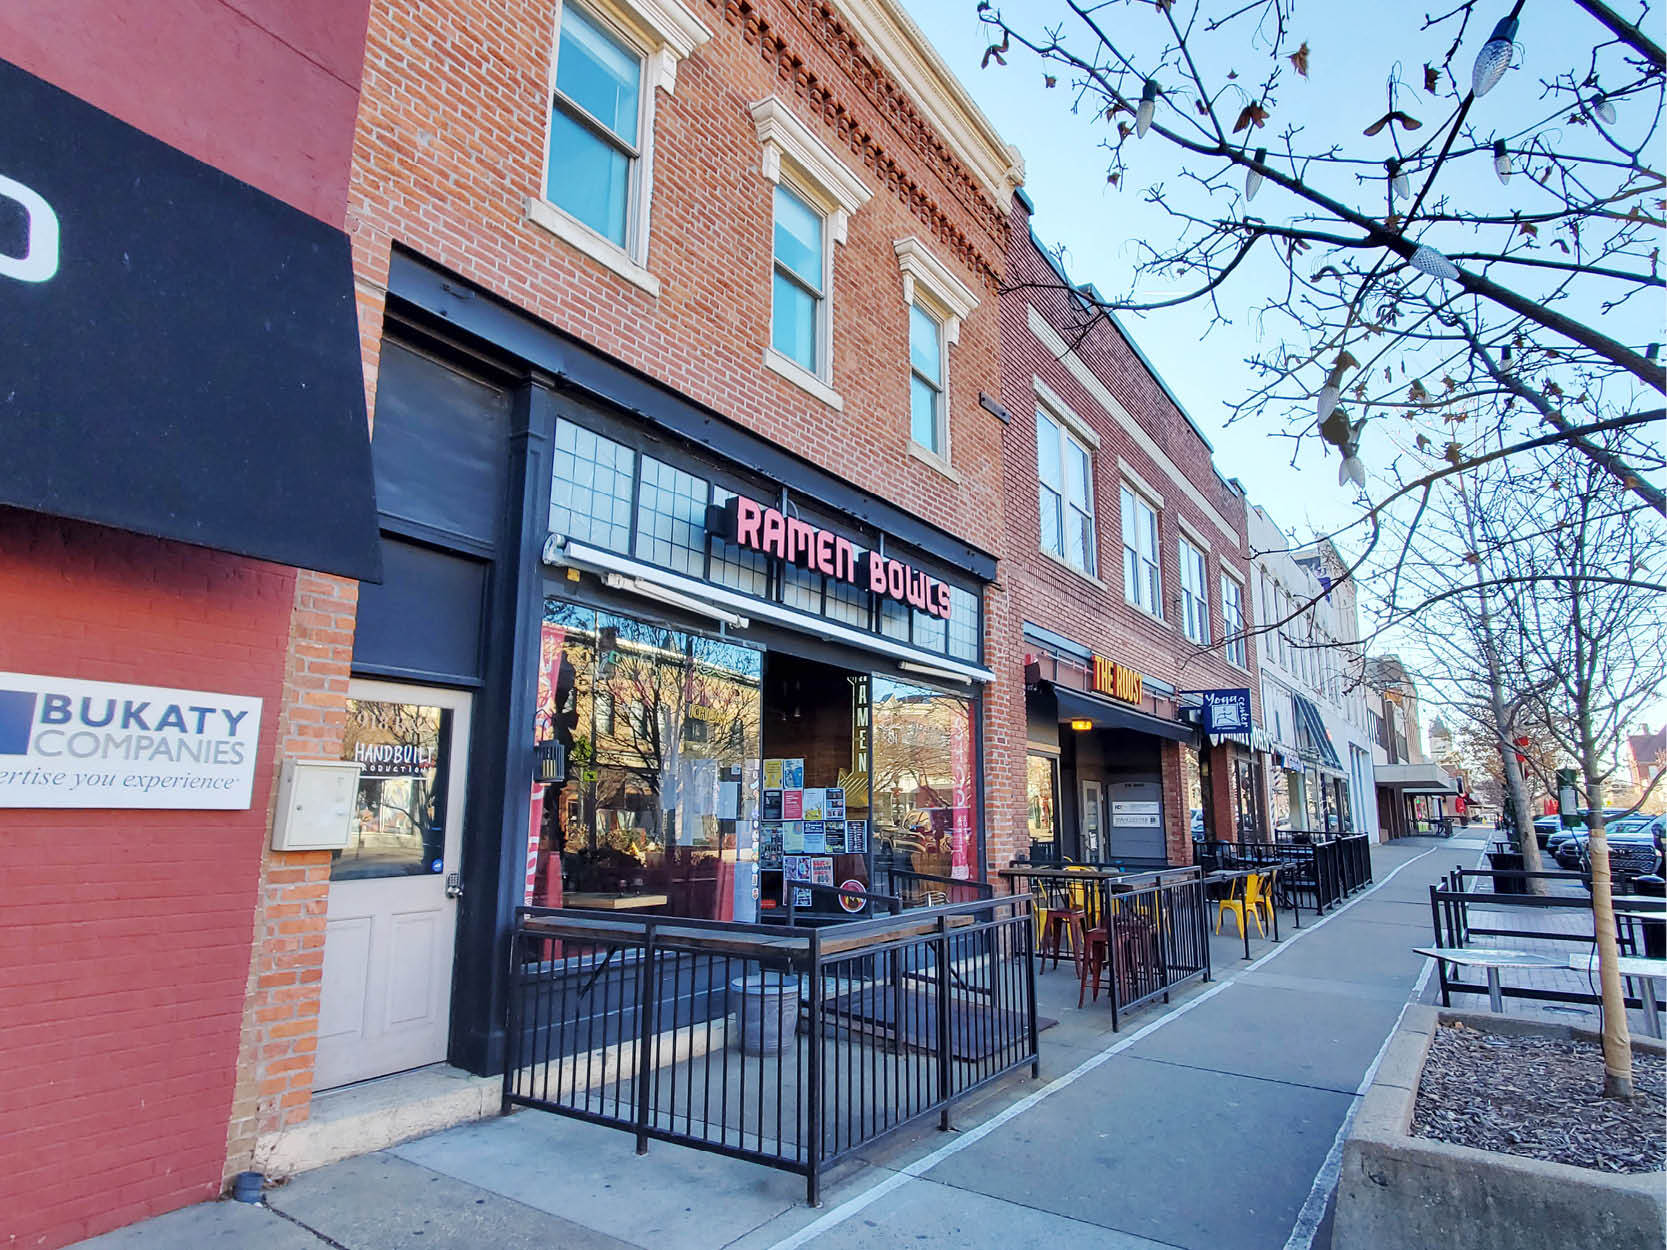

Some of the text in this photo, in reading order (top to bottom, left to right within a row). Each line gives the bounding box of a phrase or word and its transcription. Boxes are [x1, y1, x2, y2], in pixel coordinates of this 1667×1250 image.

[737, 496, 951, 620] RAMEN BOWLS
[1094, 655, 1144, 705] THE ROOST
[1205, 693, 1238, 707] Yoga
[40, 693, 248, 737] BUKATY
[856, 675, 869, 772] AMEN
[34, 729, 245, 765] COMPANIES
[353, 741, 435, 765] HANDBUILT
[70, 773, 117, 791] you
[122, 772, 235, 792] experience
